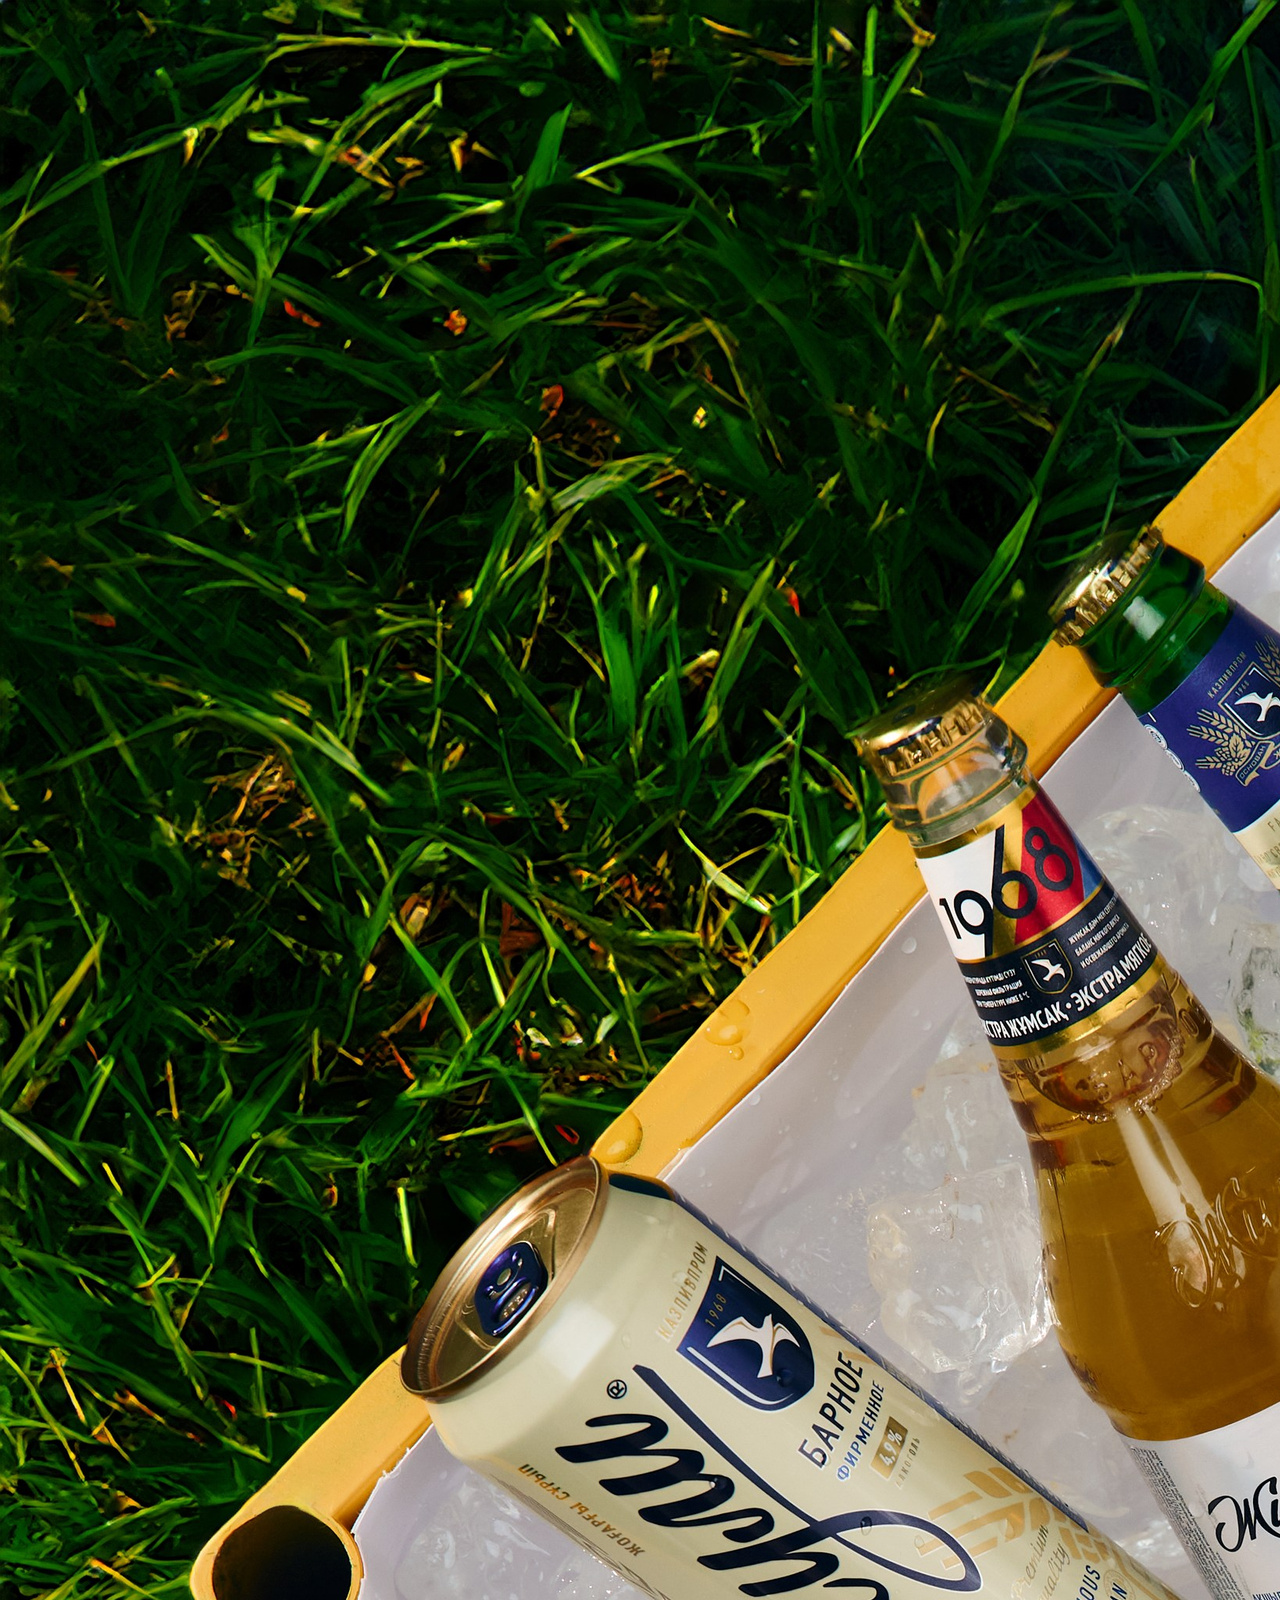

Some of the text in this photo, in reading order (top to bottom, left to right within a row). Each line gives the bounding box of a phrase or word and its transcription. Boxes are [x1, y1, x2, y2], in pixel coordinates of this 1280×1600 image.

[1208, 652, 1247, 699] КАЗПИВПРОМ
[1240, 745, 1267, 779] ОСНОВАН
[938, 824, 1074, 958] 1968
[1006, 1001, 1069, 1039] ЖҰМСАҚ
[1070, 965, 1126, 1012] ЭКСТРА
[1119, 932, 1152, 976] МЯГКОЕ
[656, 1241, 709, 1344] КАЗПИВПРОМ
[705, 1292, 728, 1328] 1968
[798, 1350, 864, 1470] БАРНОЕ
[836, 1379, 885, 1481] ФИРМЕННОЕ
[879, 1428, 903, 1467] 4,9%
[518, 1463, 646, 1557] ЖОҒАРҒЫ СҰРЫП
